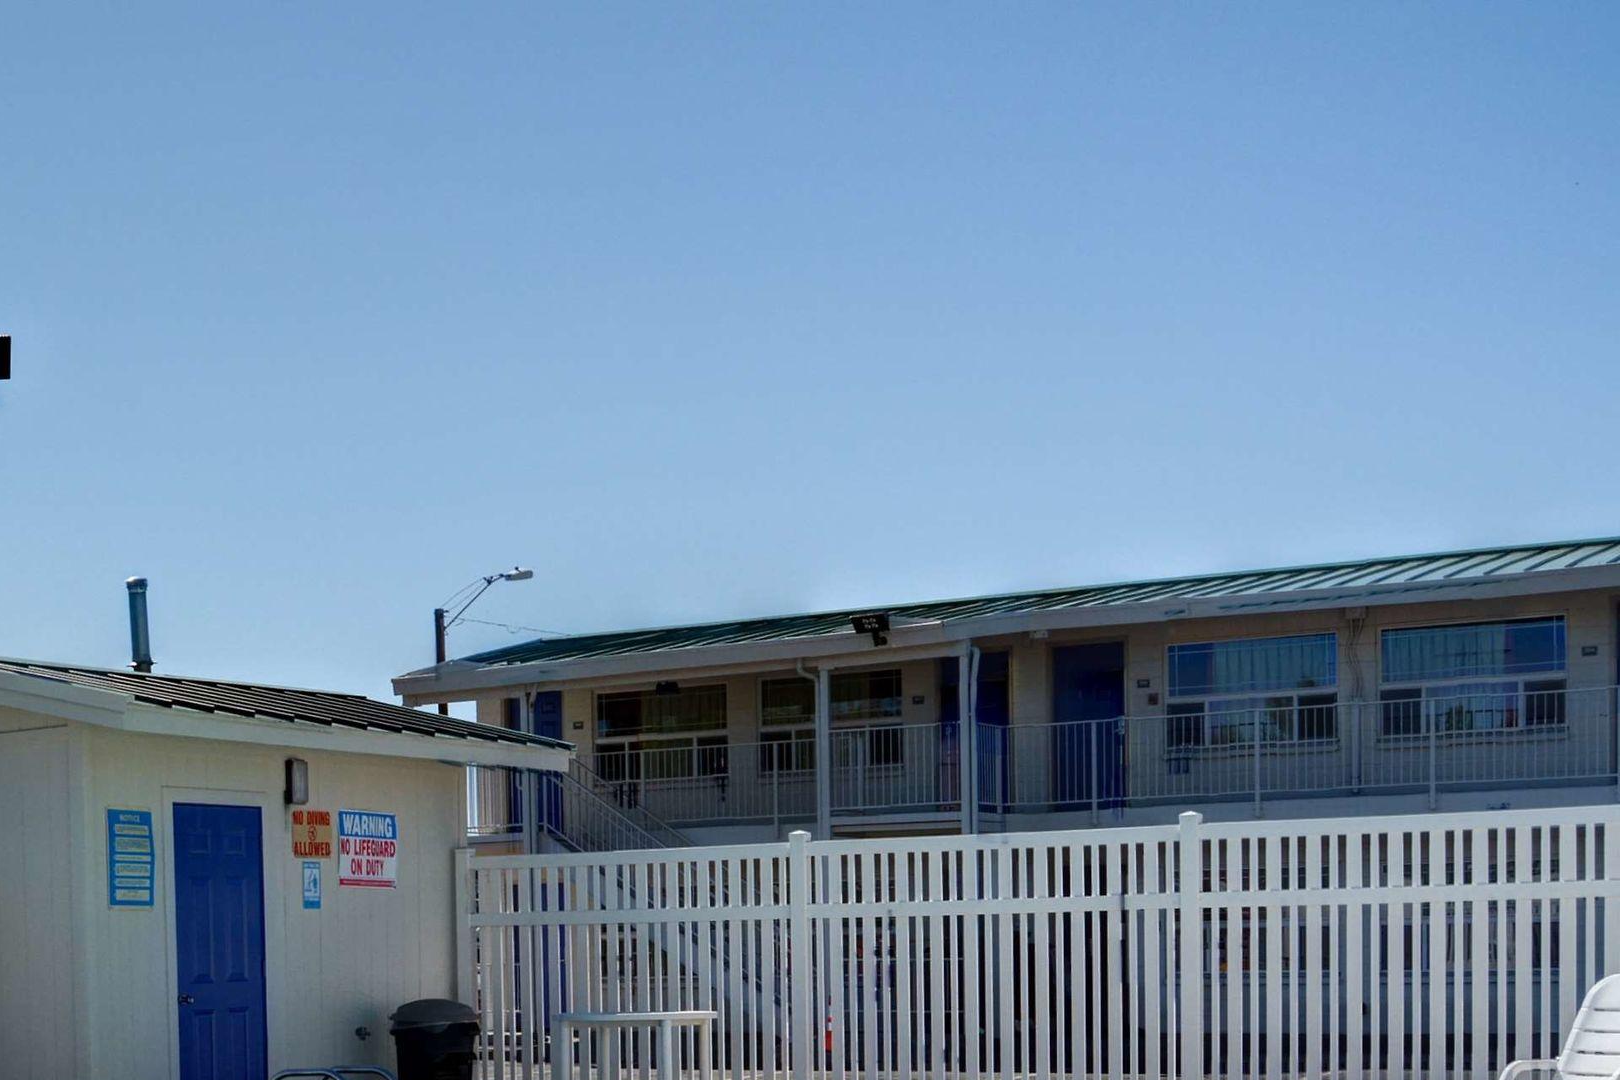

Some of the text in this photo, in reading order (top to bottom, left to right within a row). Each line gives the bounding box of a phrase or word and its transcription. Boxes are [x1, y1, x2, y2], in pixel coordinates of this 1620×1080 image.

[292, 811, 330, 825] NO DIVING
[342, 814, 393, 837] WARNING
[294, 841, 331, 856] ALLOWED
[340, 839, 396, 857] NO LIFEGUARD
[350, 859, 384, 876] ON DUTY
